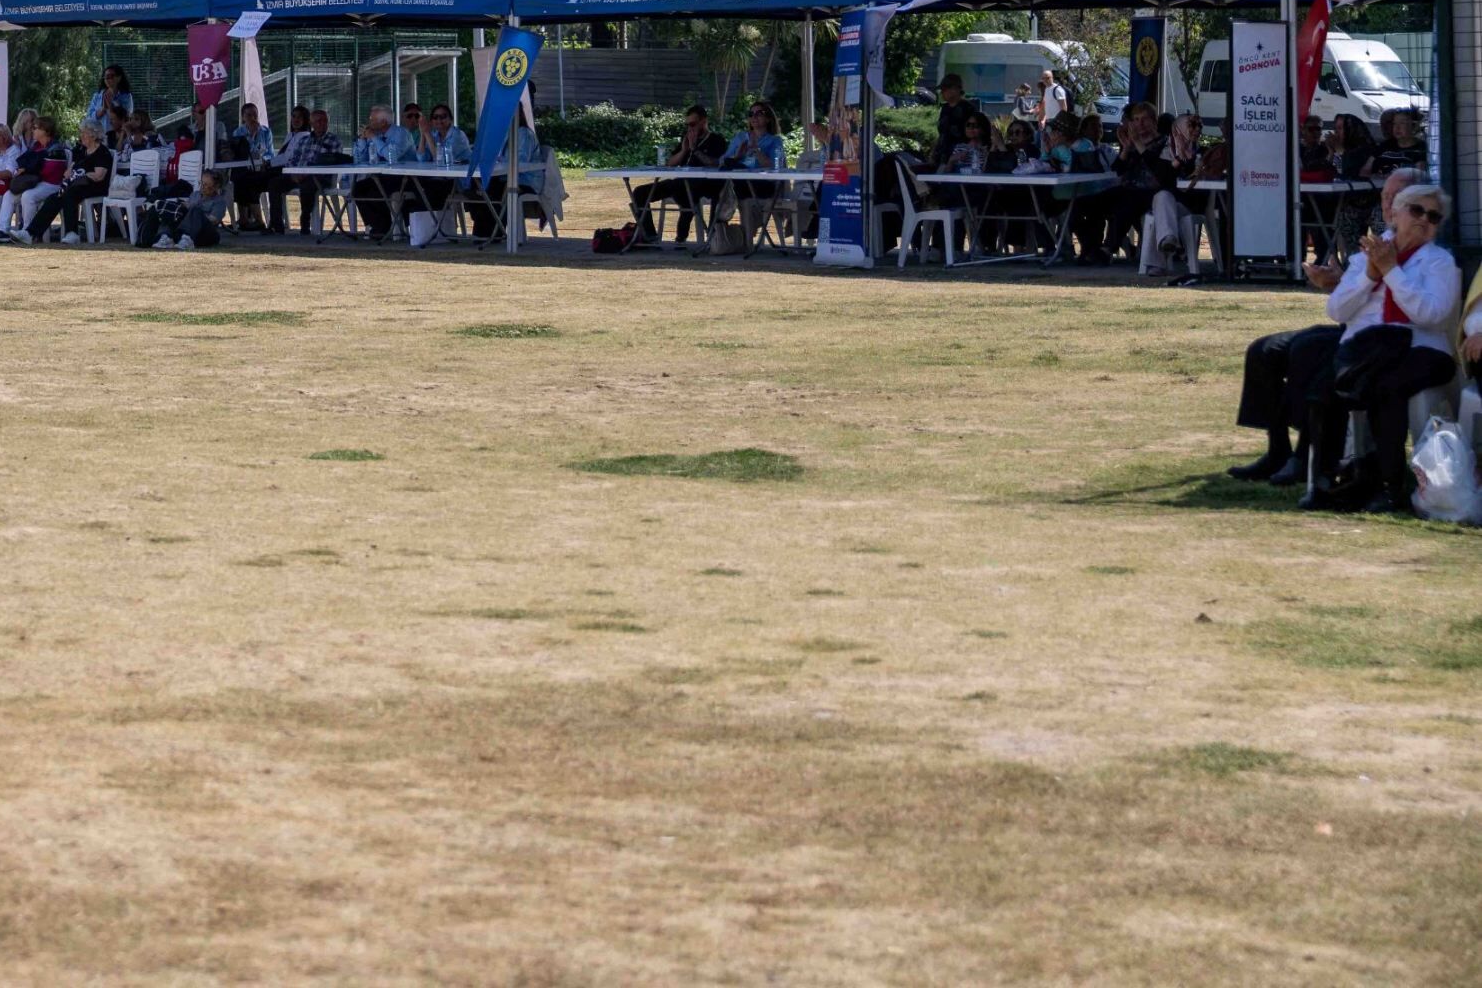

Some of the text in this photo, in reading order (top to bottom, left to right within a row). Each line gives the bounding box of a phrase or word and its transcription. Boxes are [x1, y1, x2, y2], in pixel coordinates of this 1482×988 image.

[1239, 50, 1280, 64] ÖNCÜ KENT
[1239, 58, 1280, 73] BORNOVA
[1241, 94, 1279, 106] SAĞLIK
[1244, 107, 1277, 122] İŞLERİ
[1235, 122, 1285, 132] MÜDÜRLÜĞÜ
[1250, 170, 1280, 180] Bornova
